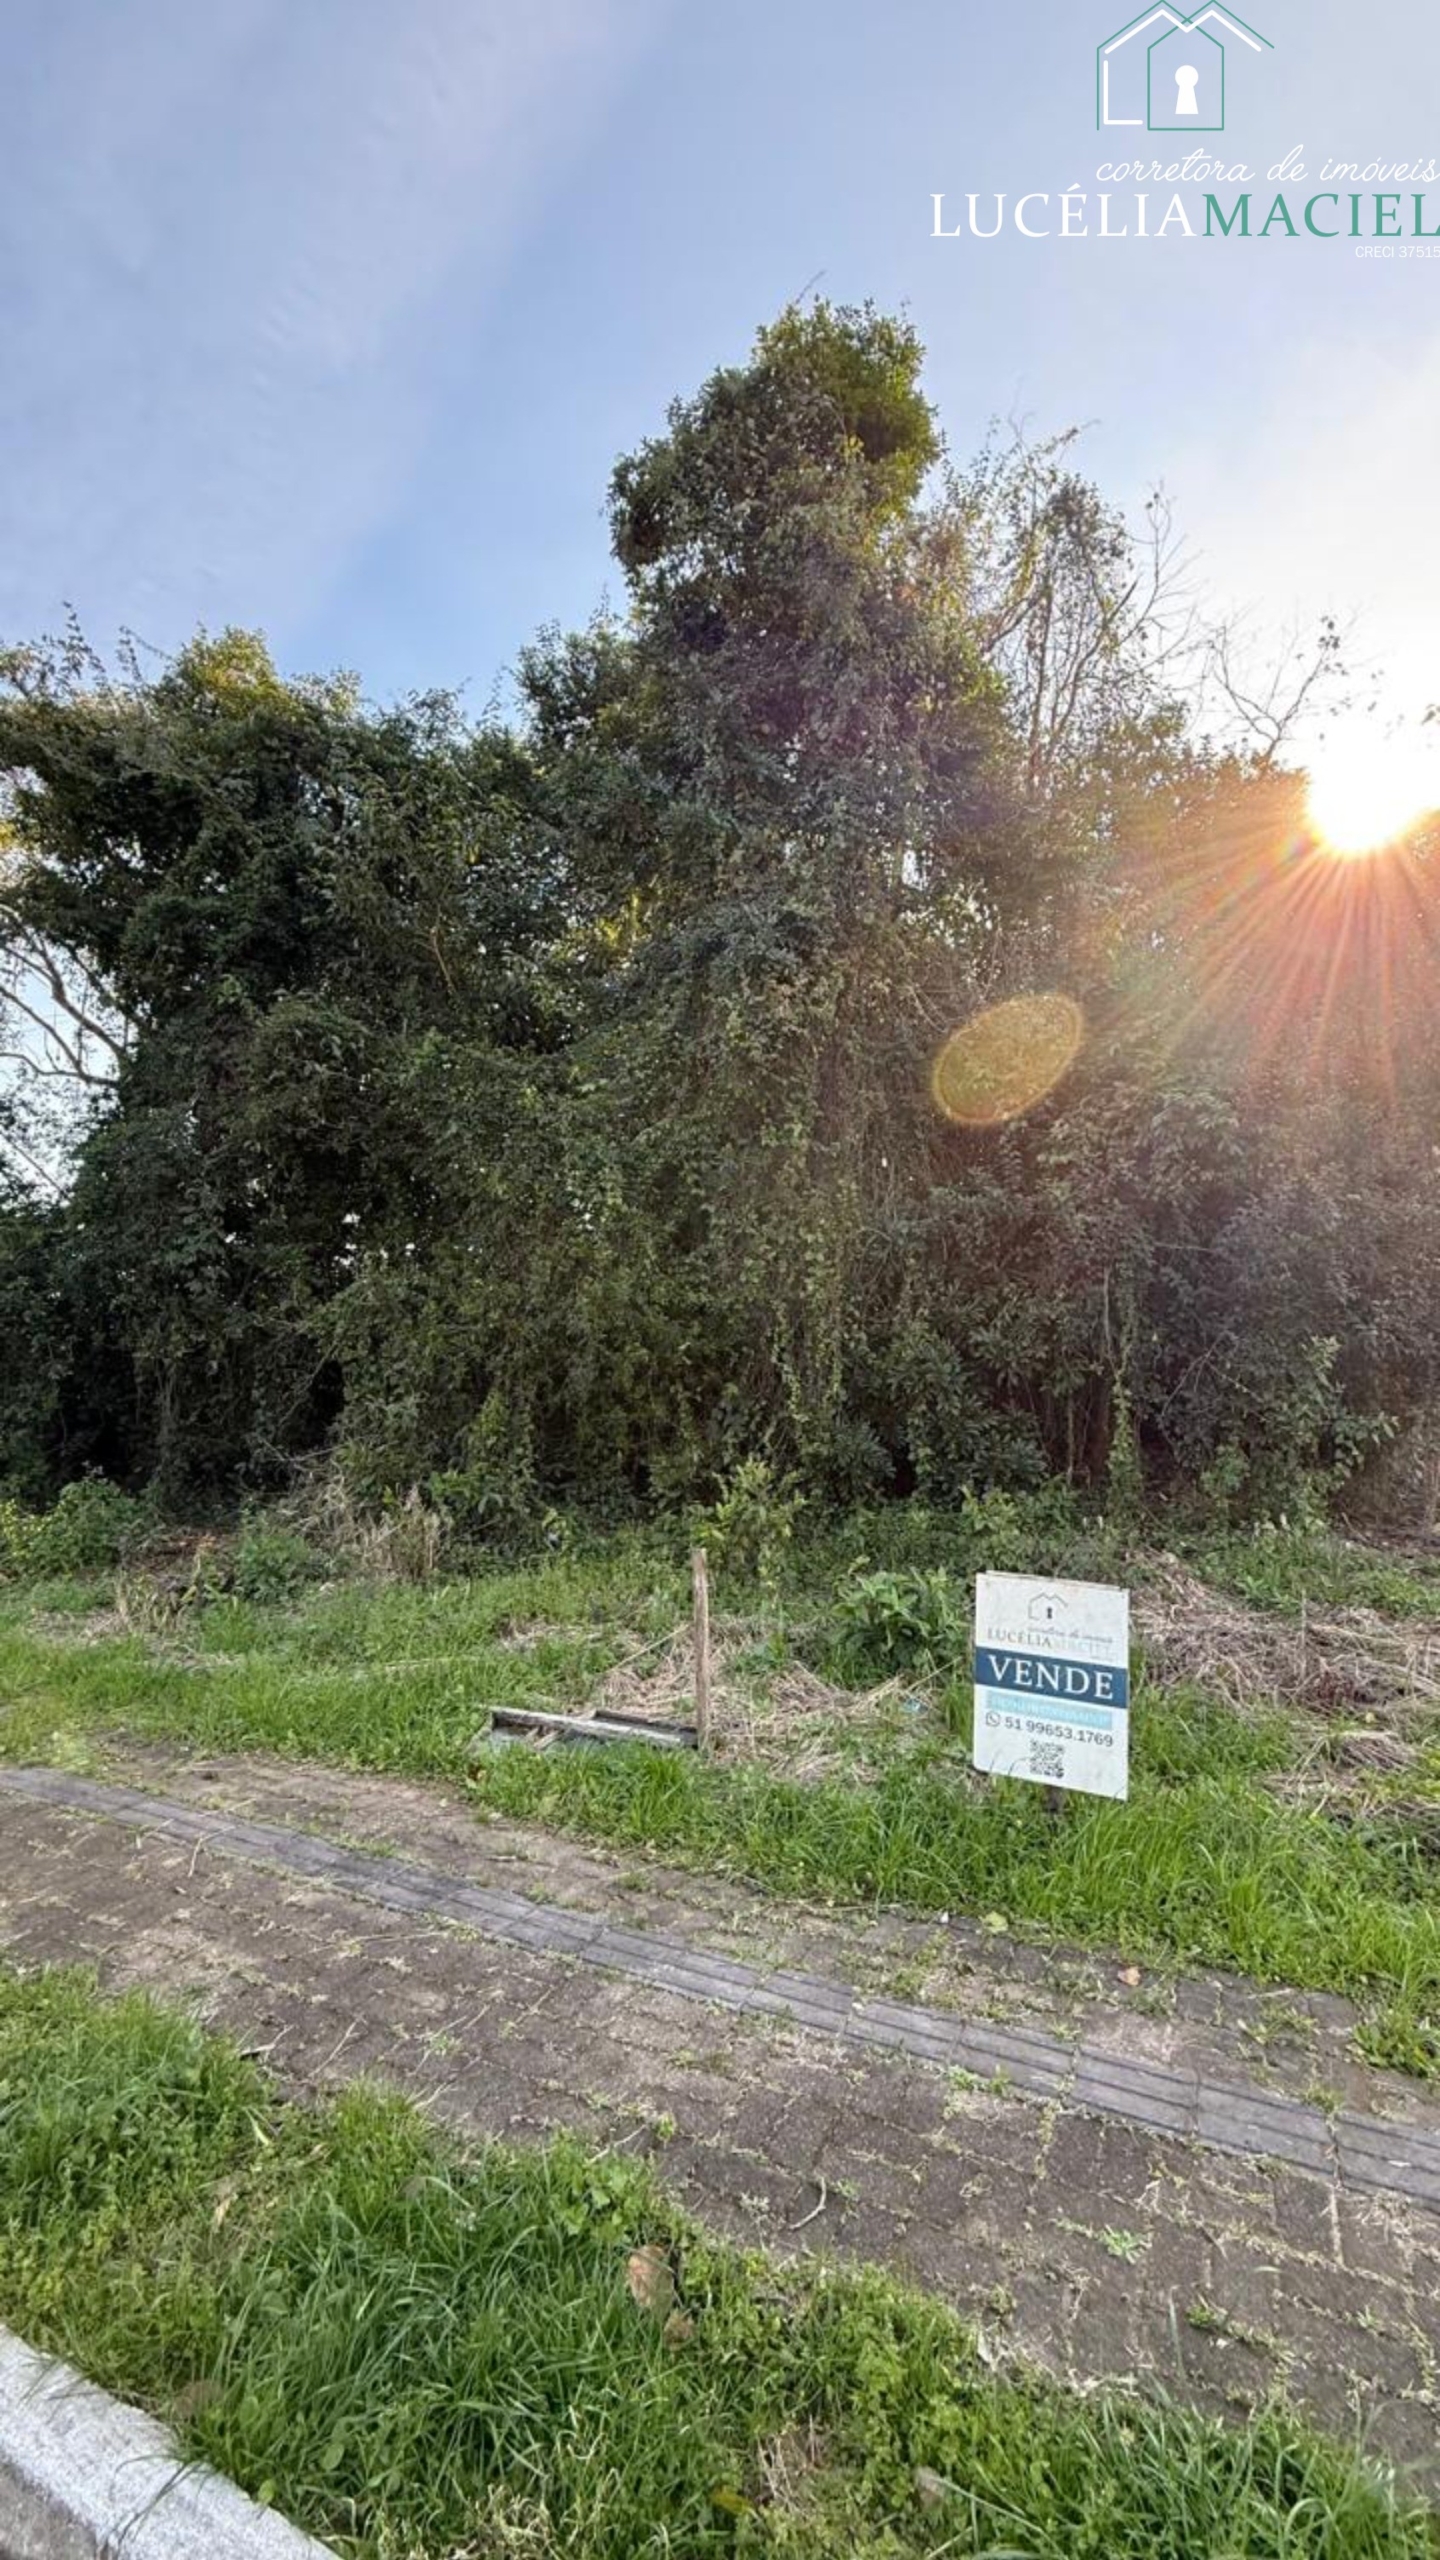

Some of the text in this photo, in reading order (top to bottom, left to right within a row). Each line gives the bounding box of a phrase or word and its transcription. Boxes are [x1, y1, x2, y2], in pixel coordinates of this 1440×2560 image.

[988, 1654, 1113, 1700] VENDE
[1005, 1716, 1114, 1748] 51 99653.1769
